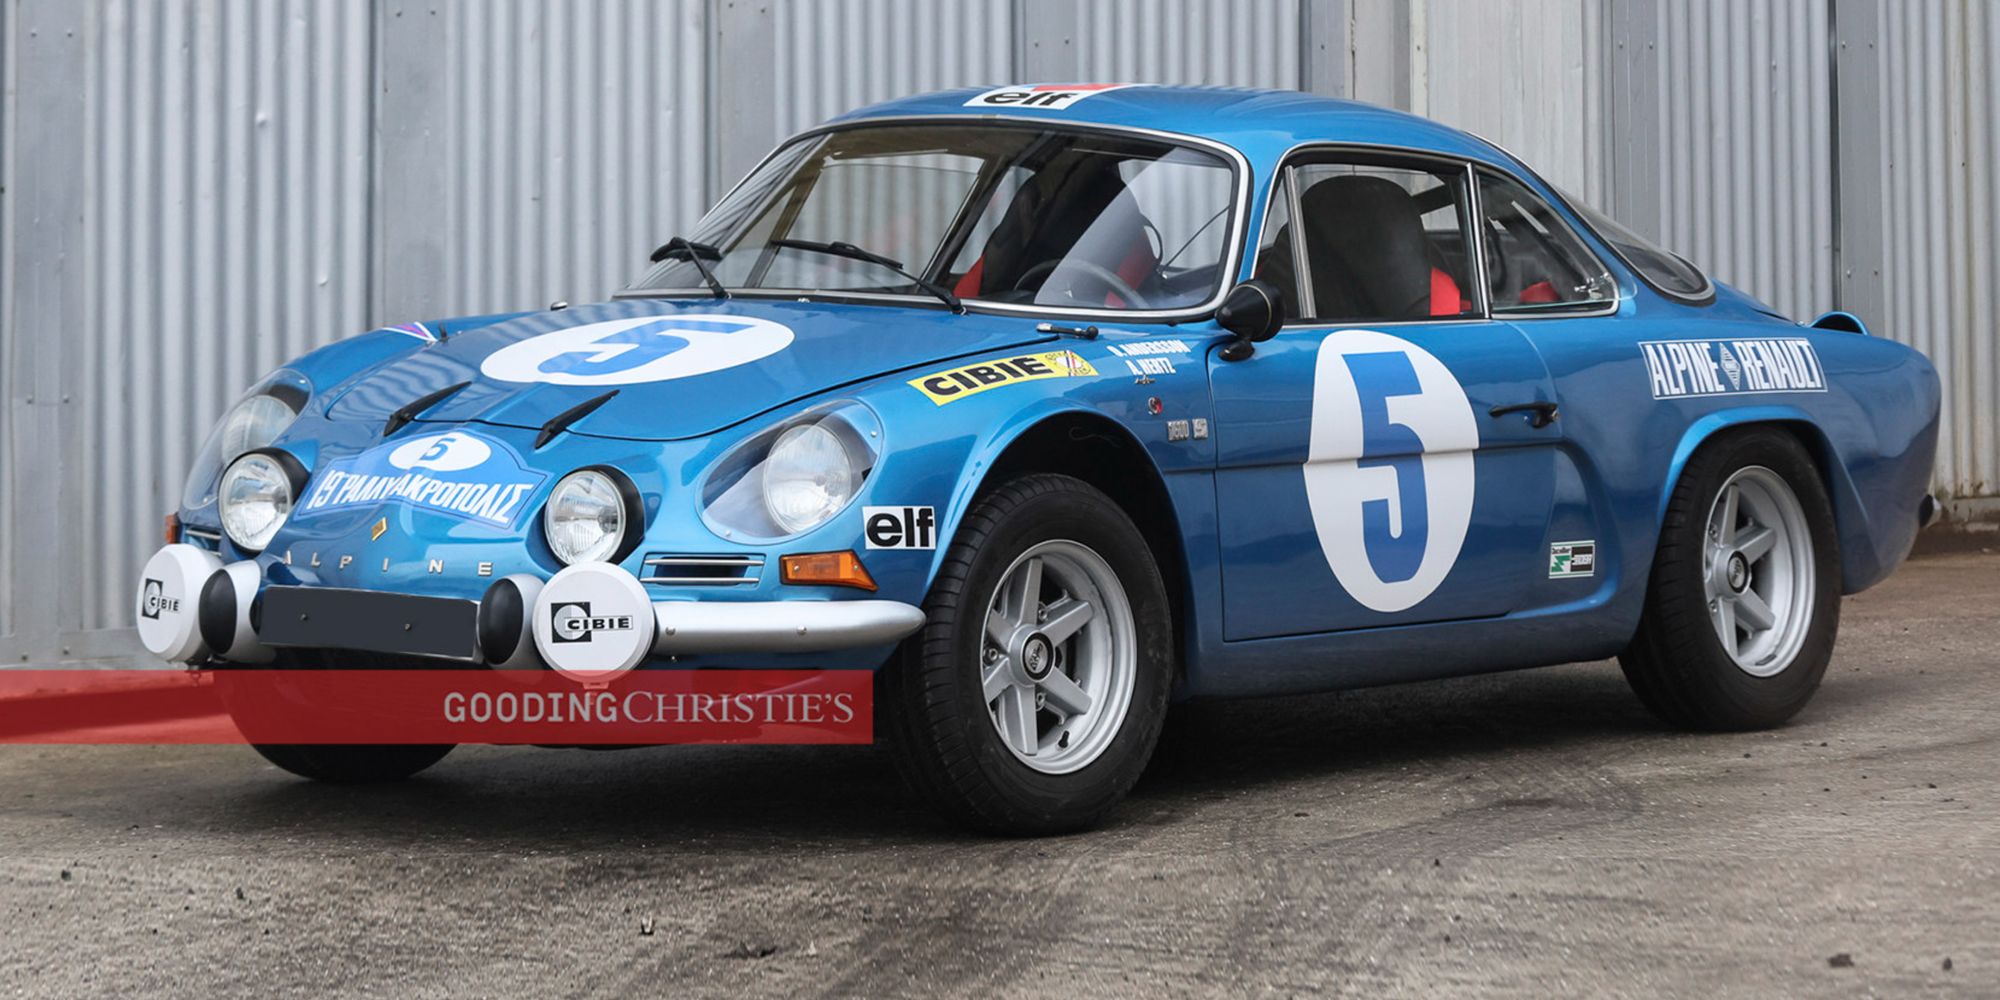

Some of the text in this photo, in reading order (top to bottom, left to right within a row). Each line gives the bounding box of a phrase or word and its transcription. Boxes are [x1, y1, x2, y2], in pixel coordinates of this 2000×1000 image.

[983, 91, 1079, 106] elf
[537, 319, 756, 376] 5
[1644, 340, 1822, 396] ALPINE RENAULT
[420, 437, 456, 461] 5
[1341, 351, 1429, 584] 5
[866, 508, 933, 547] elf
[283, 550, 493, 577] ALPINE
